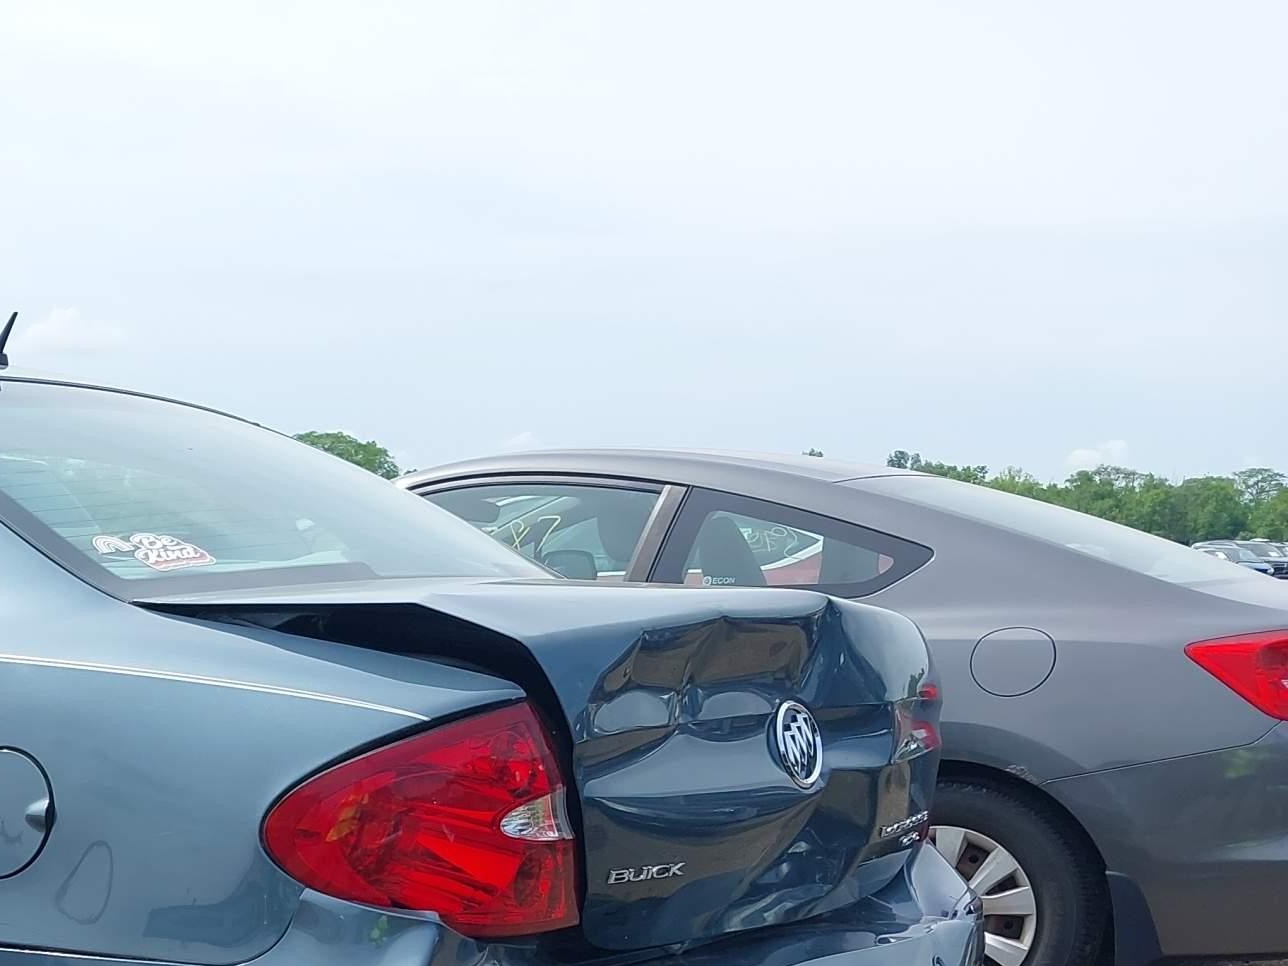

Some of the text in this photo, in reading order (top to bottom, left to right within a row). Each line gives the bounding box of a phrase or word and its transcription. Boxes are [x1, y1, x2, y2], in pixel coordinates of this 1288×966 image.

[132, 534, 178, 550] Be
[137, 545, 201, 564] Kind
[607, 862, 686, 885] BUICK
